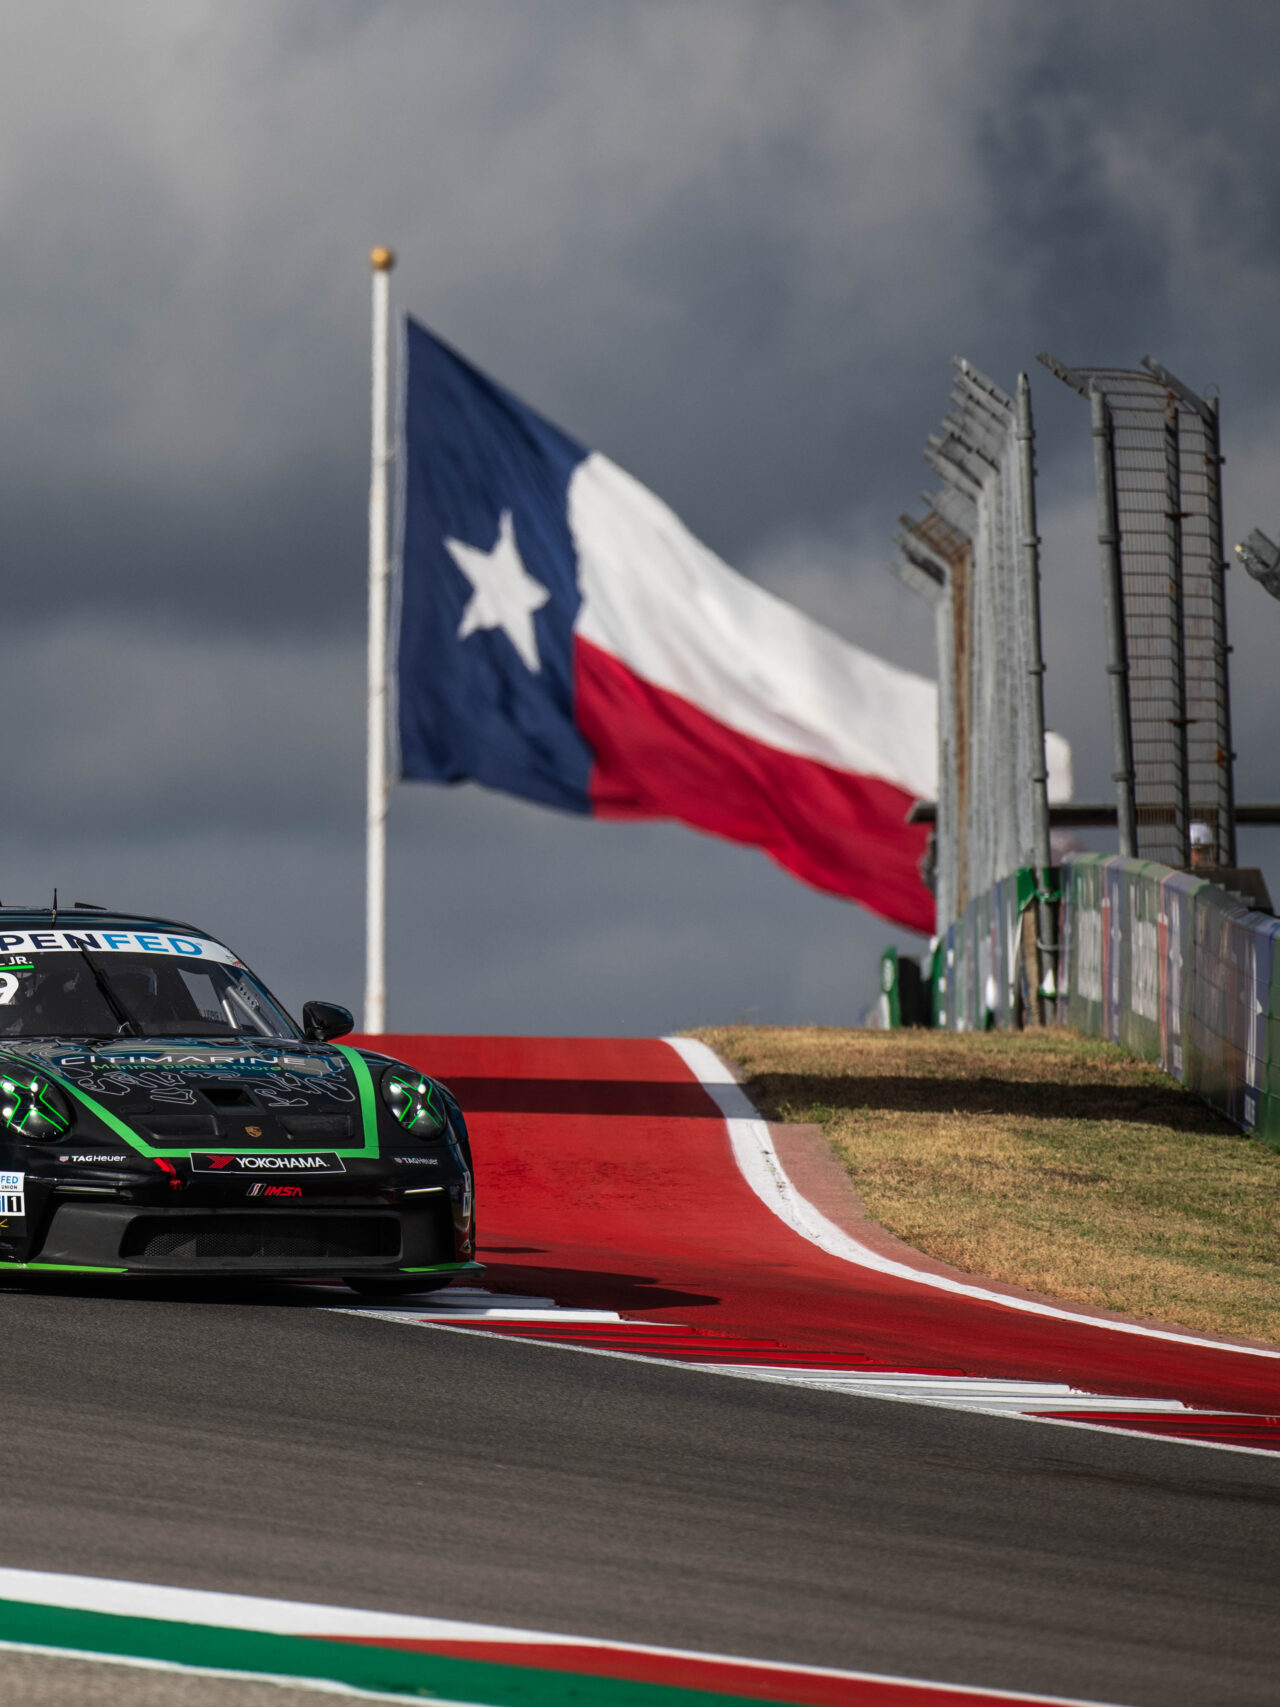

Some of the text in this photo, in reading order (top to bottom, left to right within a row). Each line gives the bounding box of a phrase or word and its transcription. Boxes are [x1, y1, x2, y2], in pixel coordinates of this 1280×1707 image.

[8, 956, 33, 966] JR.
[61, 1055, 306, 1066] CITIMARINE
[236, 1157, 327, 1169] YOKOHAMA
[264, 1186, 303, 1197] IMSA
[10, 1196, 18, 1212] 1
